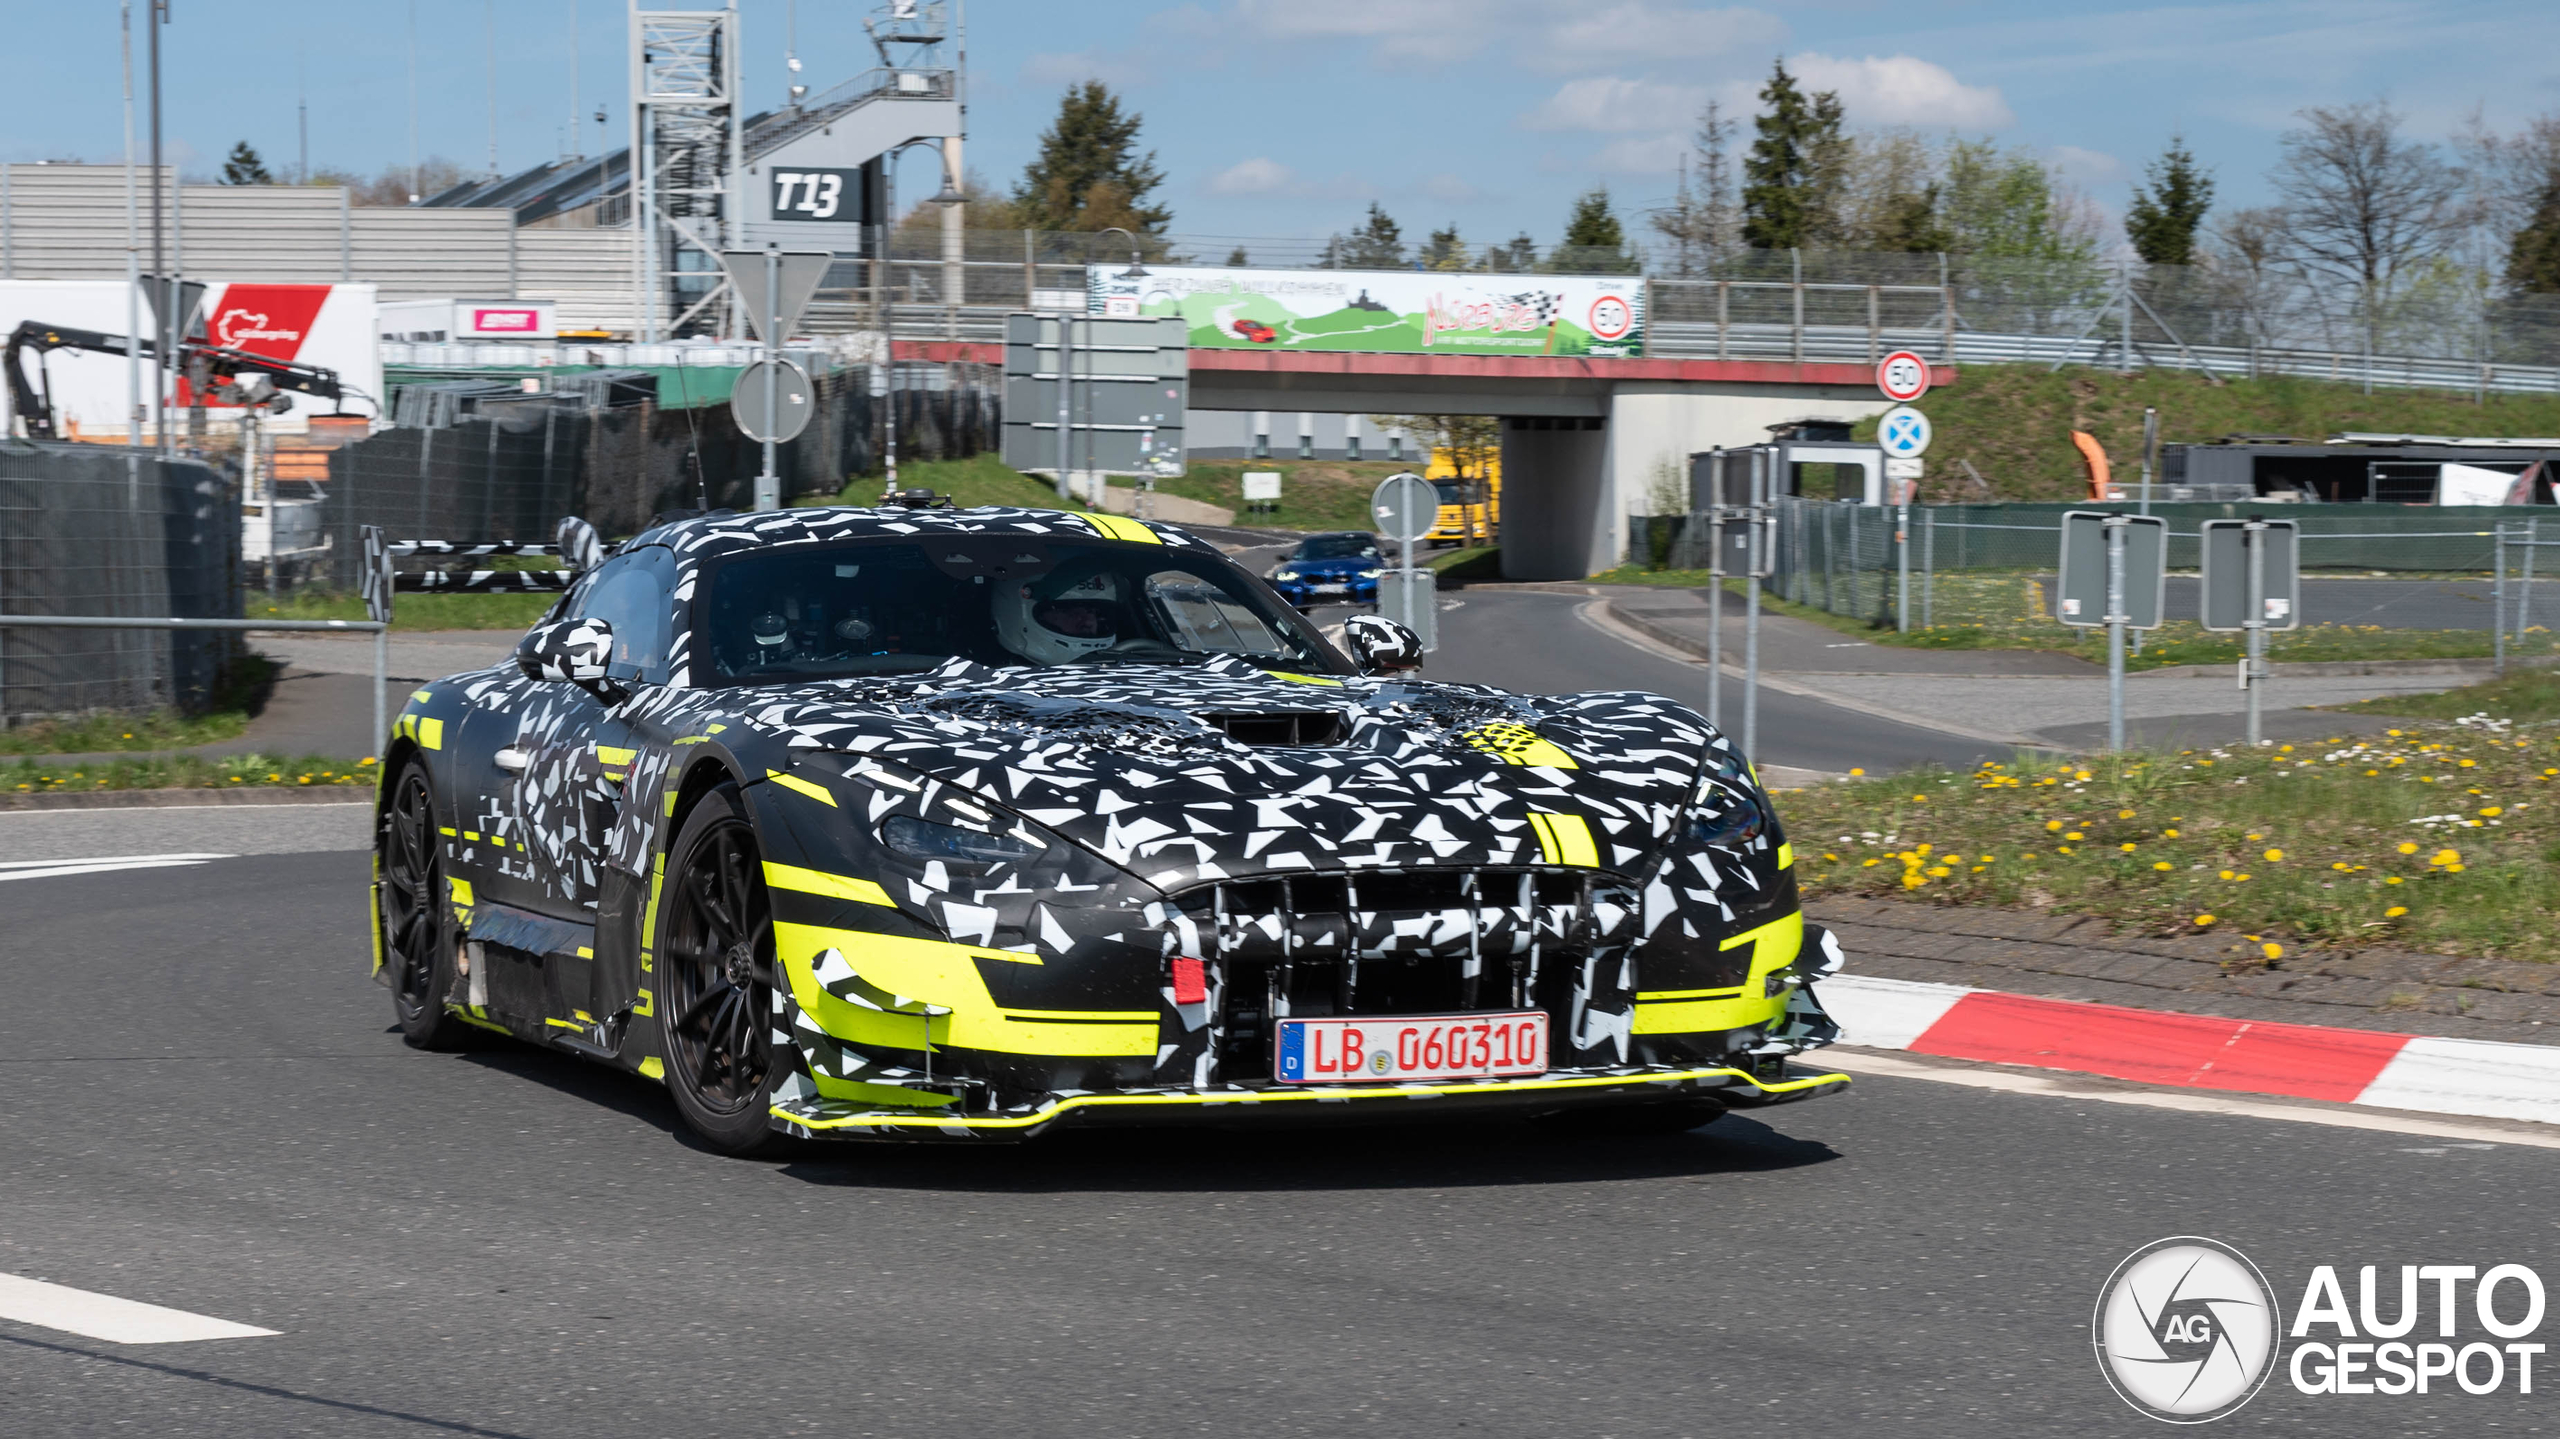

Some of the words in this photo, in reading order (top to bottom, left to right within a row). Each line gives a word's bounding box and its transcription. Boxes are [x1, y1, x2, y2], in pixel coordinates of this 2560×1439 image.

[775, 173, 843, 218] T13
[1598, 307, 1624, 327] 50
[1891, 365, 1918, 386] 50
[1286, 1056, 1297, 1070] D
[1314, 1028, 1365, 1073] LB
[1398, 1022, 1536, 1071] 060310
